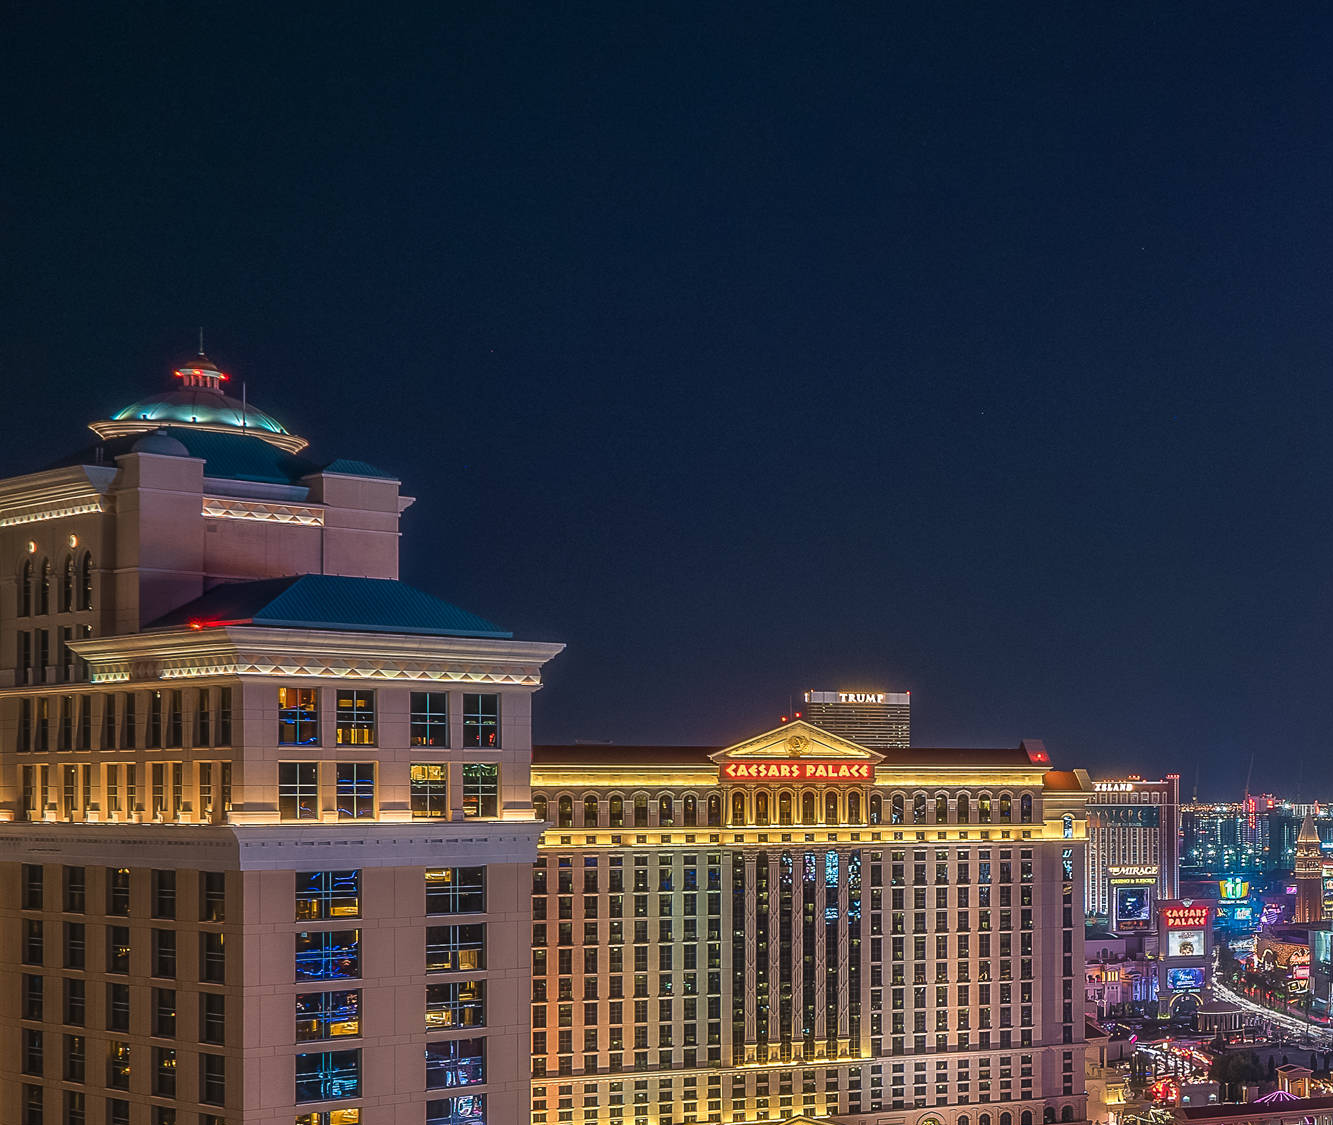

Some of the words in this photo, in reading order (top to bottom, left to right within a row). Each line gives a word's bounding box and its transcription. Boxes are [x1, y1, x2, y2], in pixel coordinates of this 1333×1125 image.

[839, 693, 884, 703] TRUMP
[725, 764, 800, 777] CAESARS
[806, 764, 868, 777] PALACE
[1115, 867, 1157, 876] MIRAGE
[1166, 909, 1207, 918] CAESARS
[1168, 917, 1205, 926] PALACE
